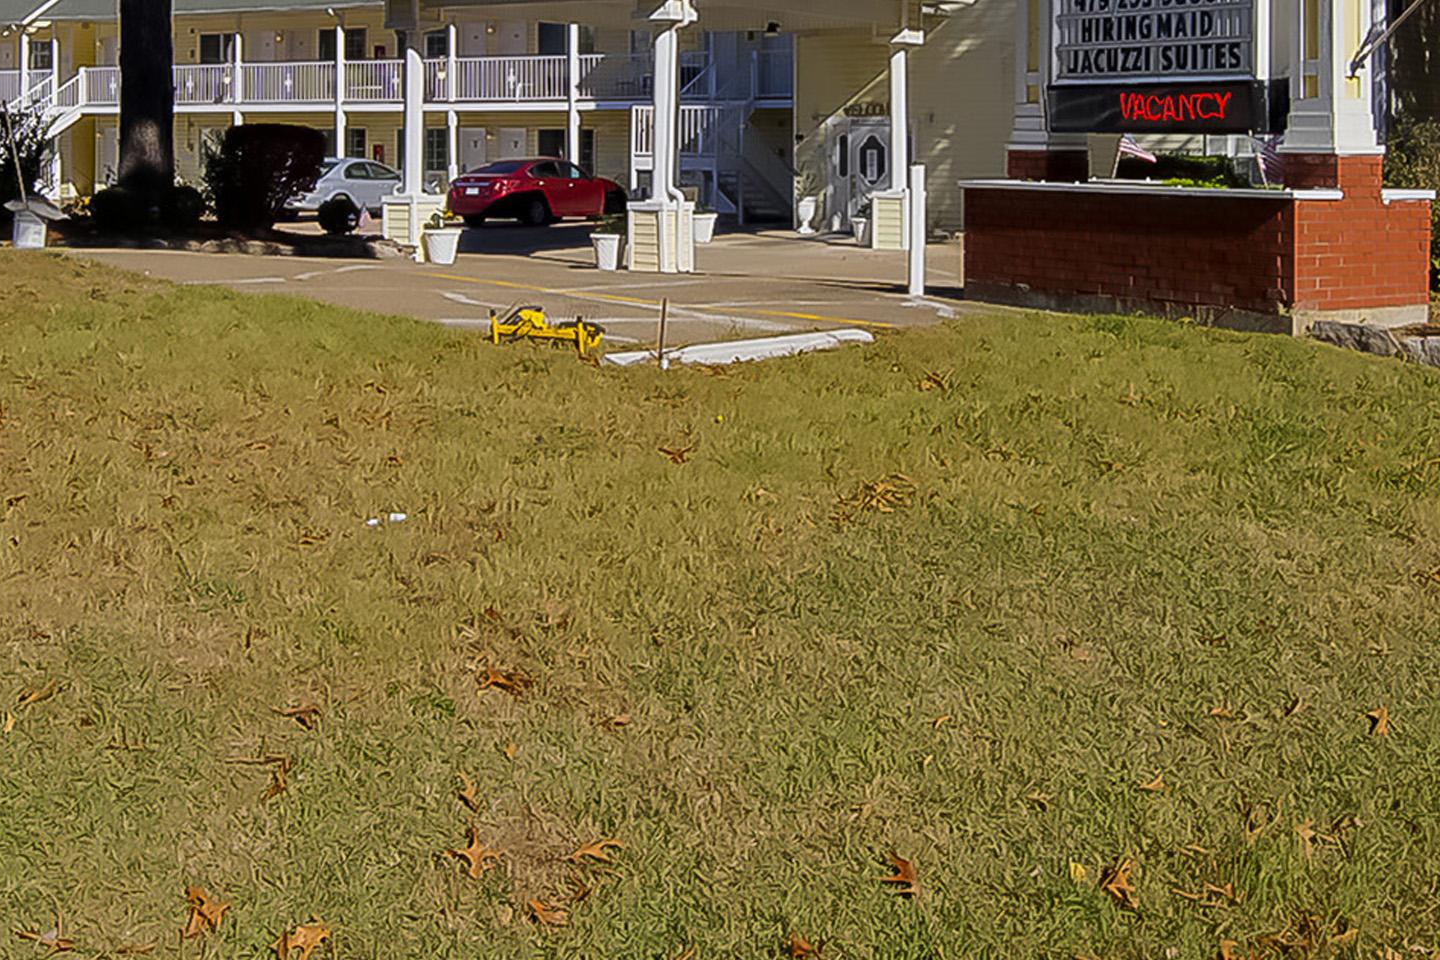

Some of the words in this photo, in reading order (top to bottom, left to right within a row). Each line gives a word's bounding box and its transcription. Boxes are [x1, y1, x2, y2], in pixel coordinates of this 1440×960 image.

[1082, 14, 1152, 43] HIRING
[1157, 11, 1213, 38] MAID
[1067, 47, 1150, 73] JACUZZI
[1162, 44, 1241, 71] SUITES
[1120, 92, 1232, 121] VACANCY
